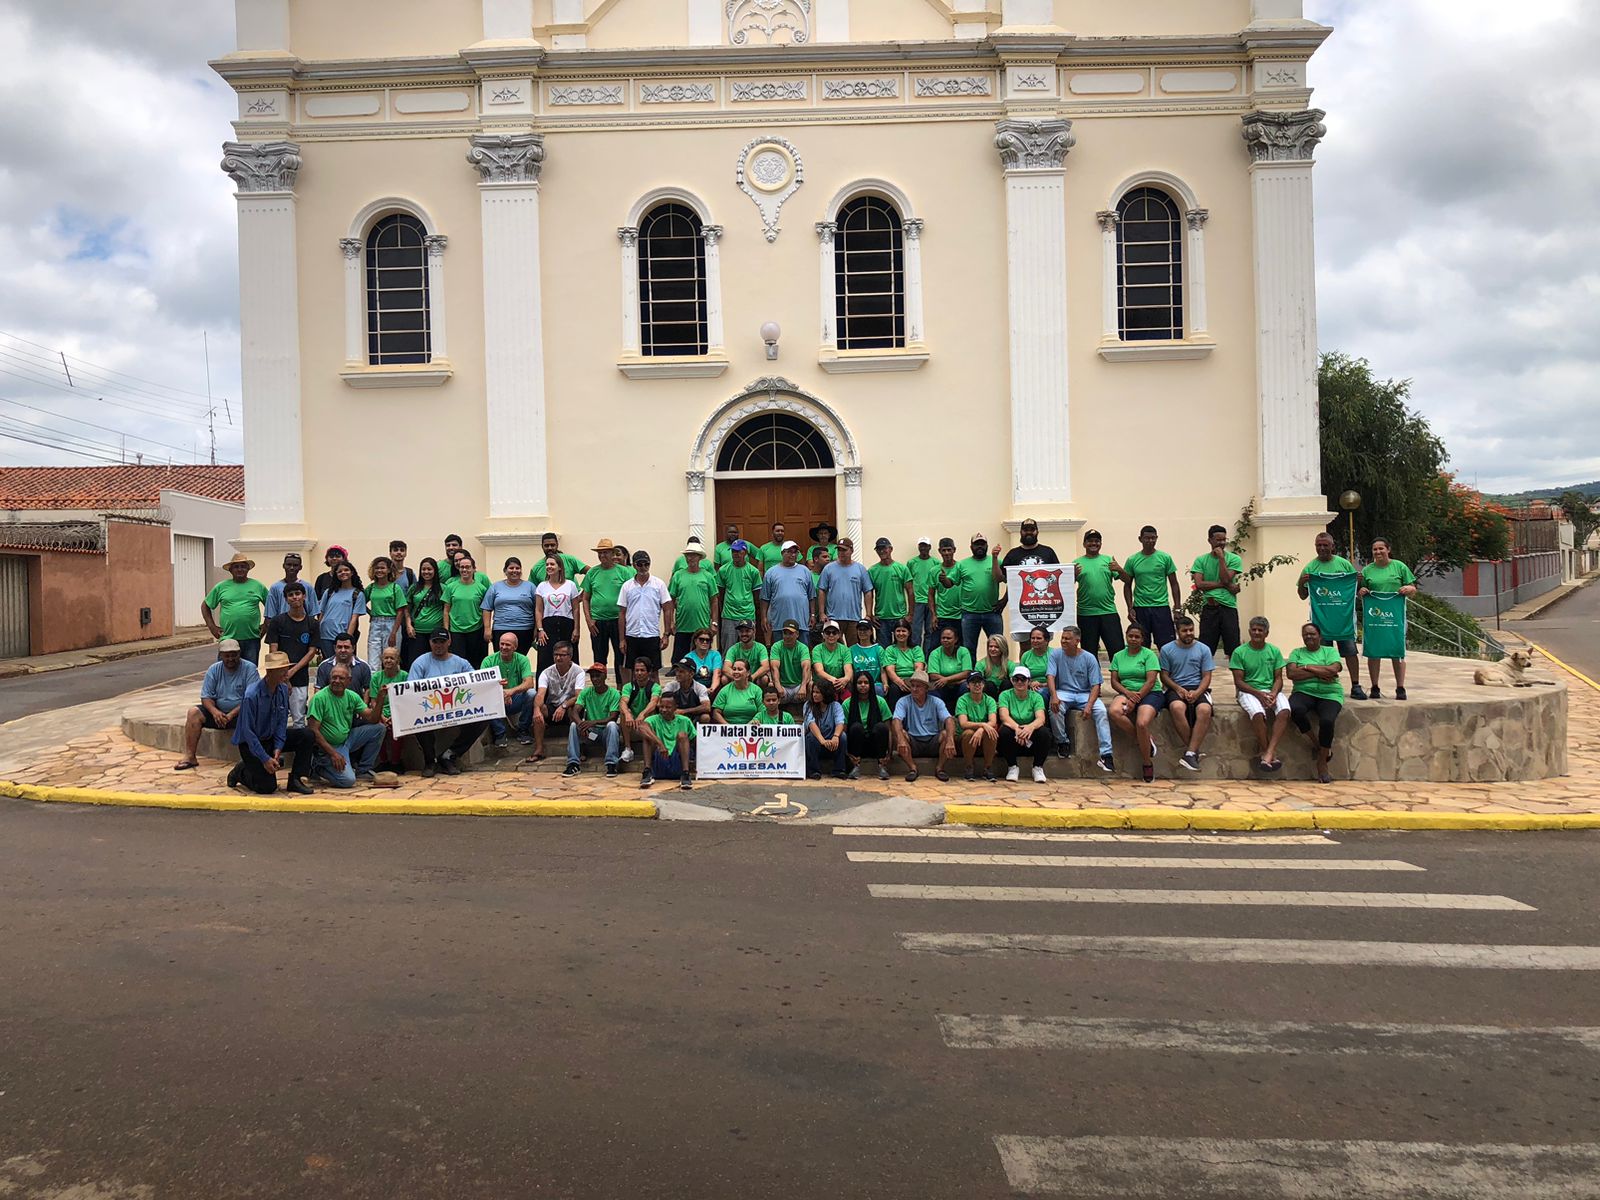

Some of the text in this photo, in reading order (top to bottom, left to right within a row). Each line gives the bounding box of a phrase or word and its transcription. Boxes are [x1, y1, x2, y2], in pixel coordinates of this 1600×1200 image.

[414, 680, 442, 693] Natal
[444, 675, 468, 688] Sem
[469, 670, 496, 683] Fome
[720, 725, 748, 737] Natal
[750, 725, 773, 737] Sem
[776, 725, 802, 737] Fome
